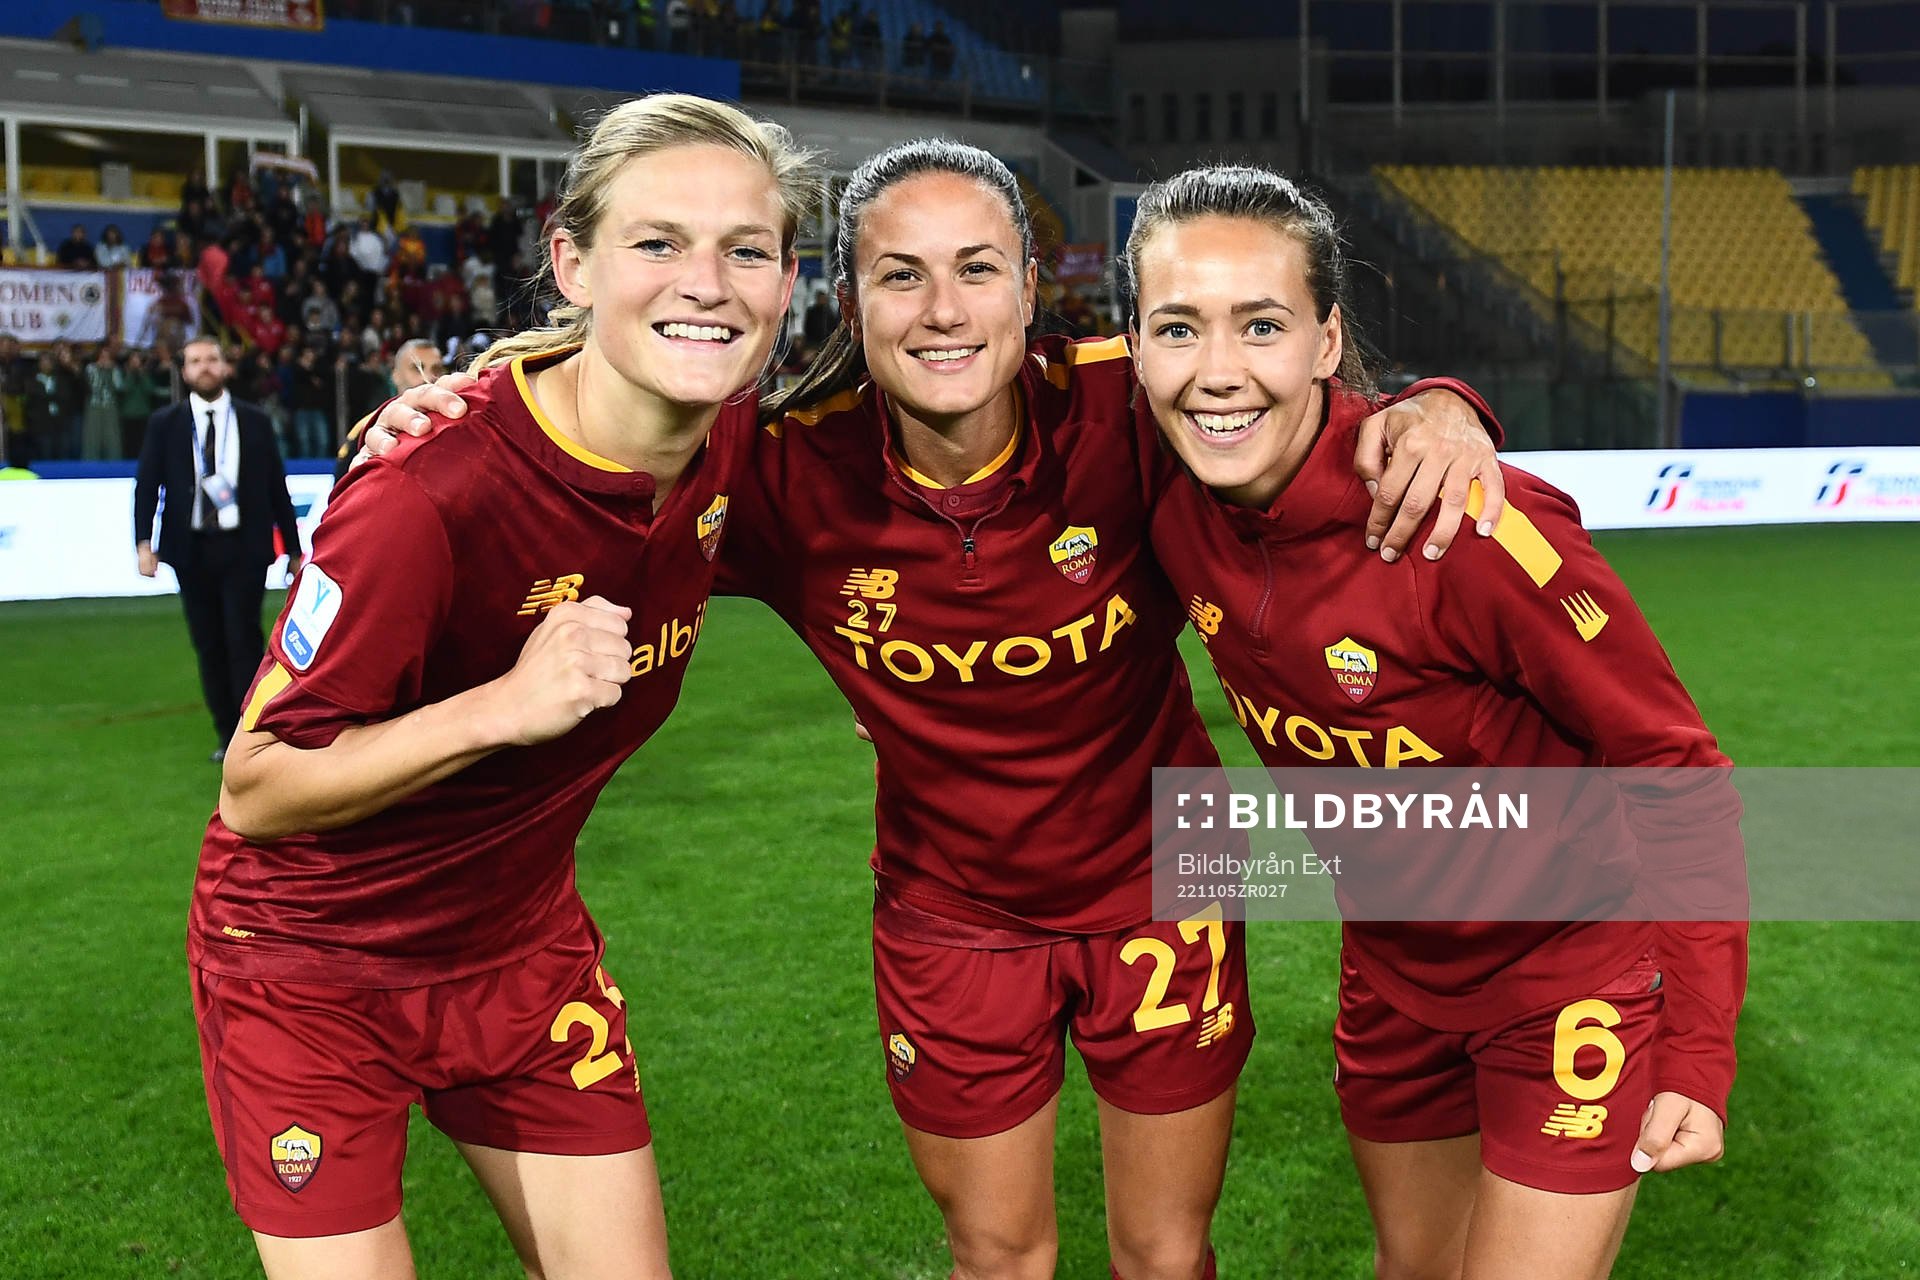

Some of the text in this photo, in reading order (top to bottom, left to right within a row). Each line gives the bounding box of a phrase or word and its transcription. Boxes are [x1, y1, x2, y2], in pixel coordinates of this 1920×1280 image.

[0, 280, 75, 304] OMEN
[0, 309, 43, 330] LUB
[1062, 553, 1096, 575] ROMA
[1075, 568, 1089, 579] 1927
[847, 600, 898, 633] 27
[834, 594, 1137, 683] TOYOTA
[1337, 673, 1374, 687] ROMA
[1349, 687, 1364, 696] 1927
[1221, 675, 1444, 769] OYOTA
[1119, 901, 1226, 1033] 27
[1553, 999, 1626, 1101] 6
[278, 1163, 313, 1174] ROMA
